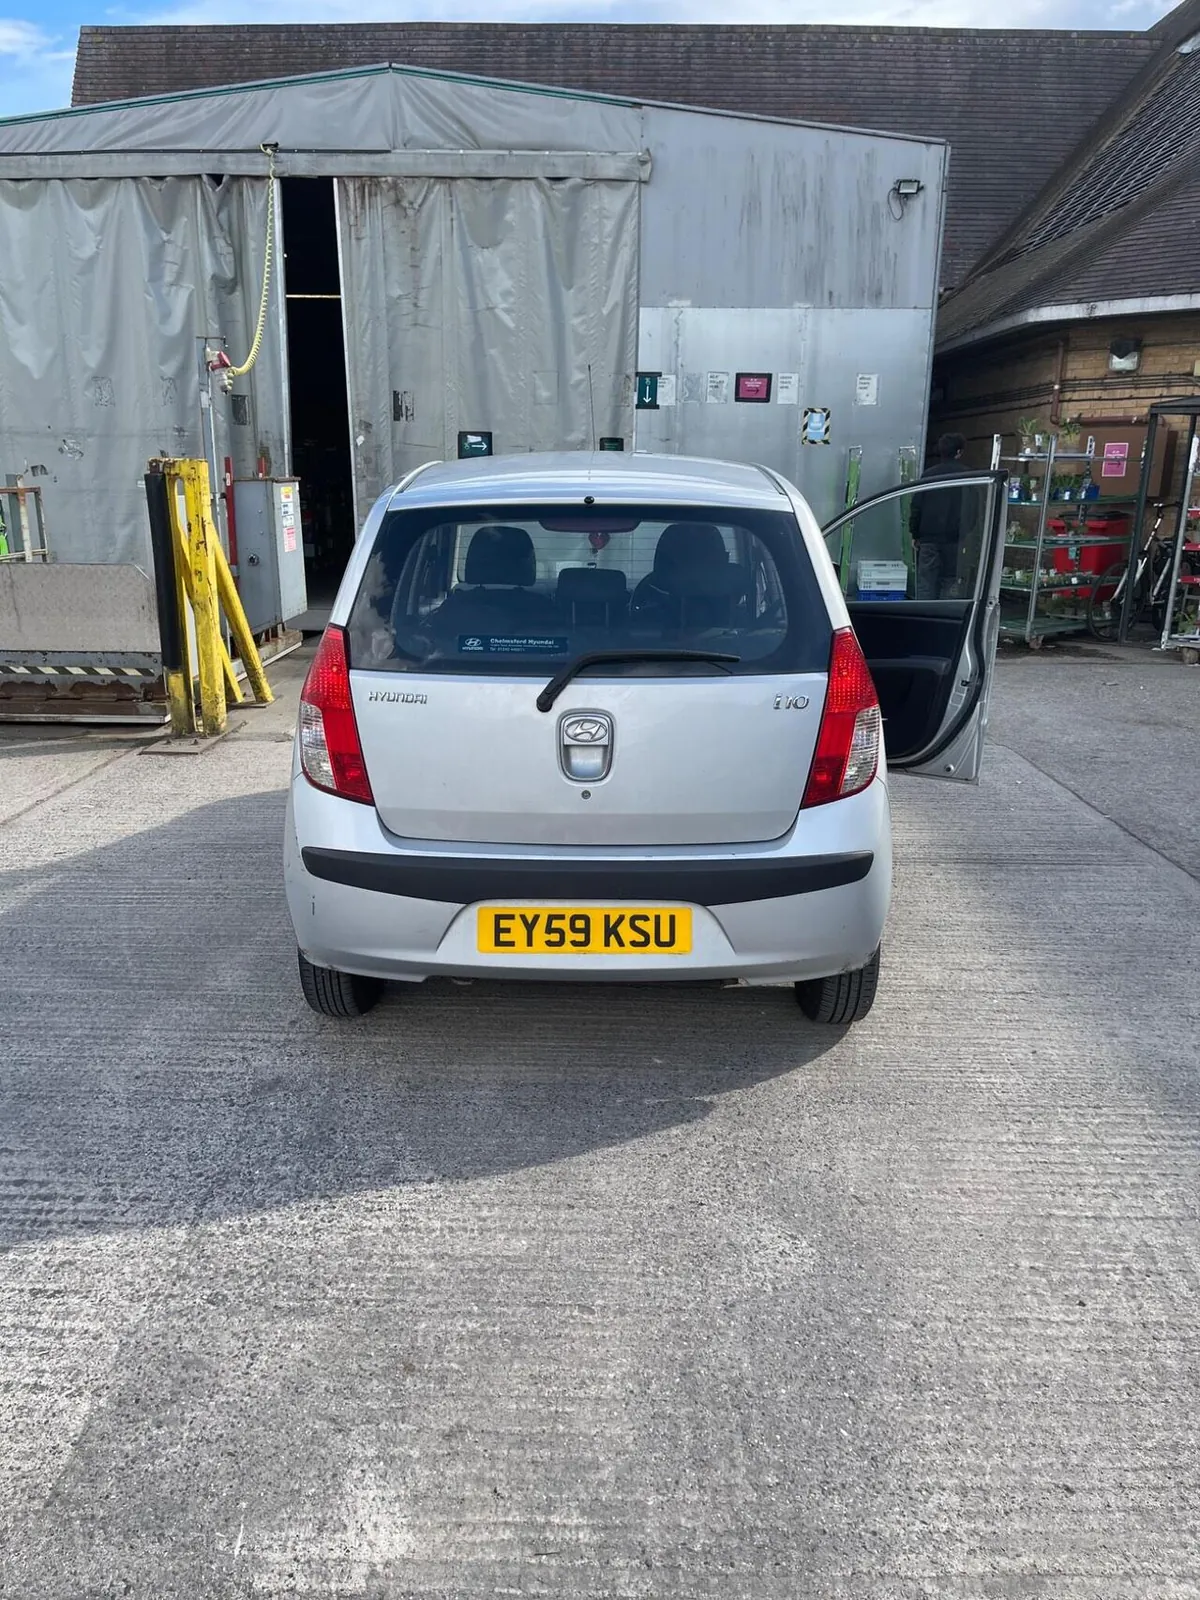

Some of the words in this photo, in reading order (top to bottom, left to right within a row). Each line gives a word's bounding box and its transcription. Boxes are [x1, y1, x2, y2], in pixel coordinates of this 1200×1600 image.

[368, 691, 428, 705] HYUNDAI
[773, 693, 810, 710] i10
[493, 913, 591, 948] EY59
[604, 913, 676, 948] KSU
